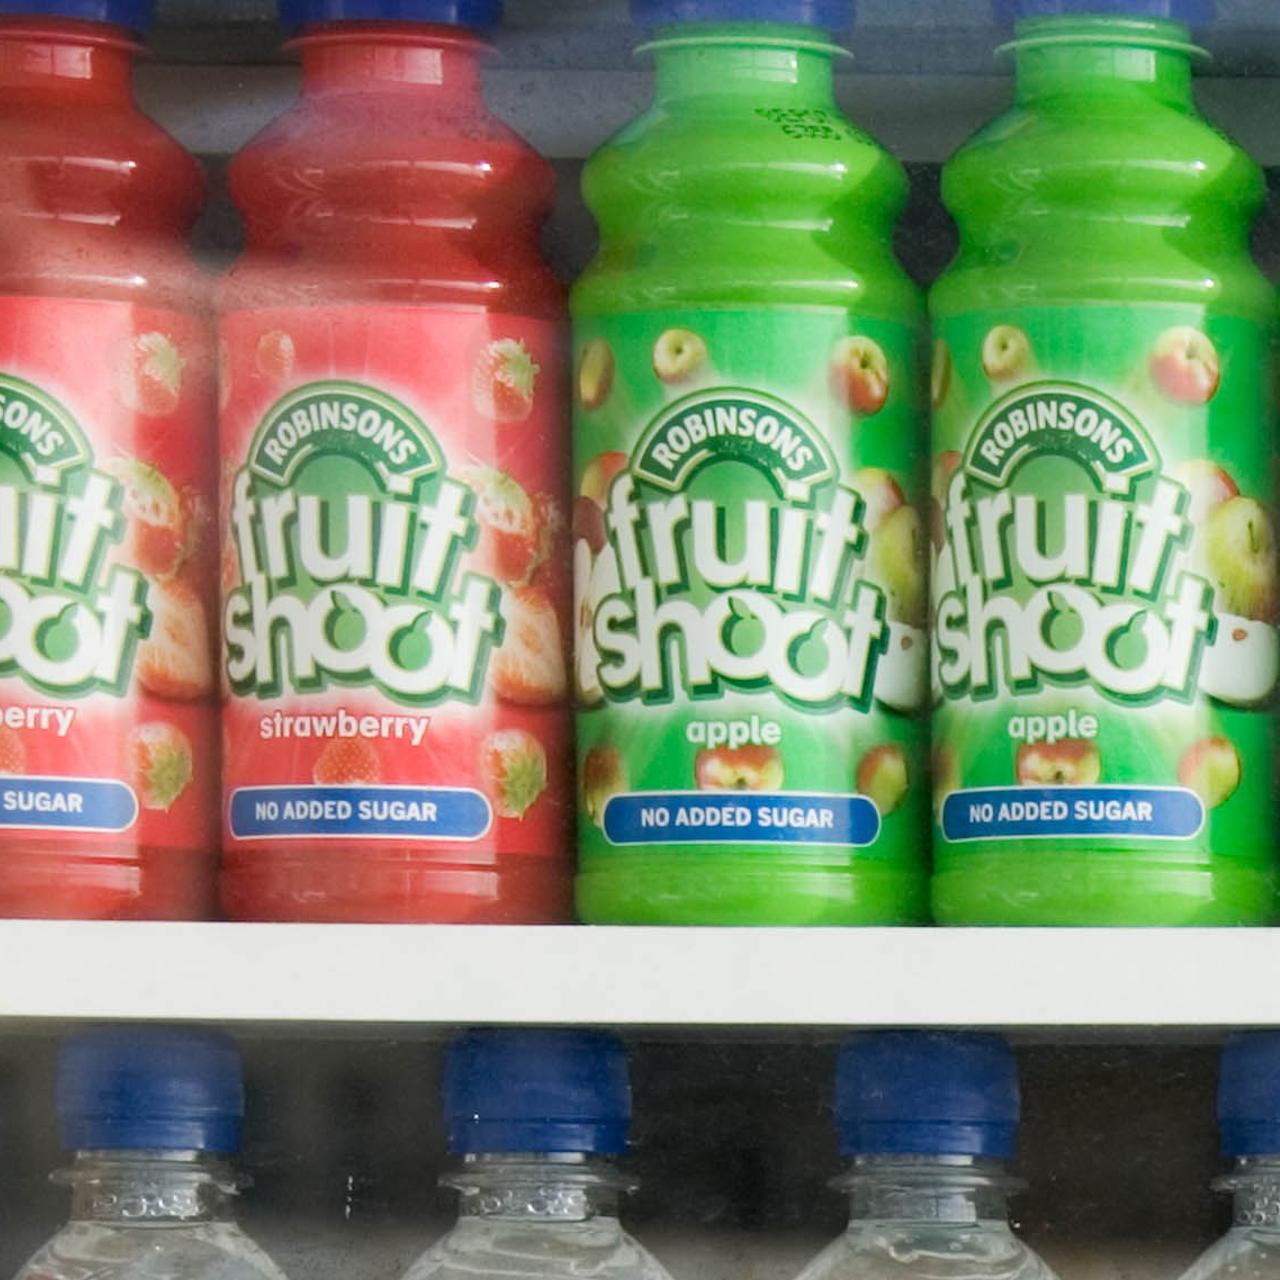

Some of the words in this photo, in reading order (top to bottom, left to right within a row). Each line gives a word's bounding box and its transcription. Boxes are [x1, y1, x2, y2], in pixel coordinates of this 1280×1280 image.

[267, 403, 418, 466] ROBINSONS
[652, 408, 814, 471] ROBINSONS
[980, 400, 1135, 466] ROBINSONS
[234, 471, 471, 585] fruit
[604, 477, 861, 596] fruit
[946, 470, 1182, 585] fruit
[225, 578, 496, 694] shoot
[598, 576, 879, 705] shoot
[938, 570, 1211, 694] shoot
[260, 710, 428, 744] strawberry
[686, 717, 781, 750] apple
[1008, 710, 1097, 741] apple
[4, 791, 83, 813] SUGAR
[256, 800, 278, 820] NO
[284, 799, 351, 821] ADDED
[357, 799, 436, 823] SUGAR
[641, 807, 667, 827] NO
[674, 806, 748, 828] ADDED
[755, 807, 833, 829] SUGAR
[970, 802, 991, 823] NO
[998, 801, 1068, 824] ADDED
[1074, 800, 1152, 823] SUGAR
